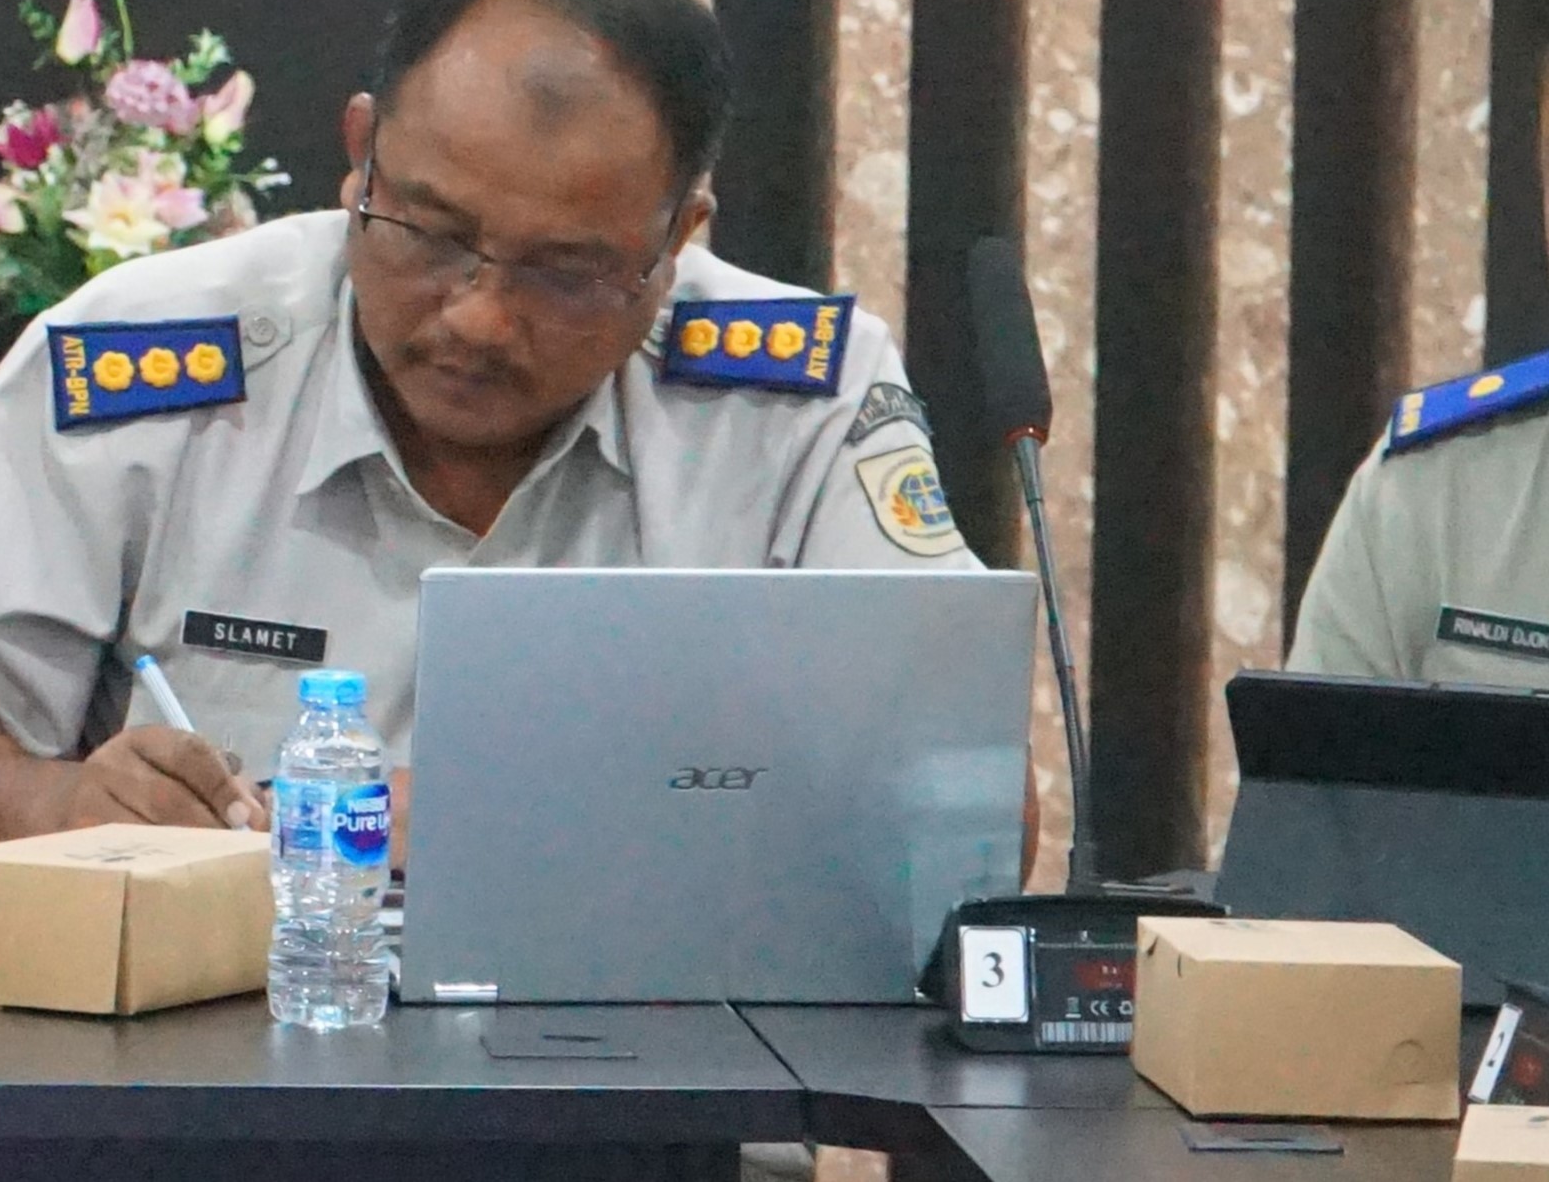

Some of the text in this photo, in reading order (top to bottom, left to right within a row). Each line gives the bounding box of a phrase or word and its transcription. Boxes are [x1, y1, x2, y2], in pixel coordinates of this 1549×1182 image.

[805, 304, 841, 382] ATR-BPN
[61, 335, 91, 416] ATR-BPN
[213, 622, 298, 651] SLAMET
[666, 766, 770, 791] acer
[981, 951, 1006, 989] 3
[1486, 1030, 1506, 1069] 2
